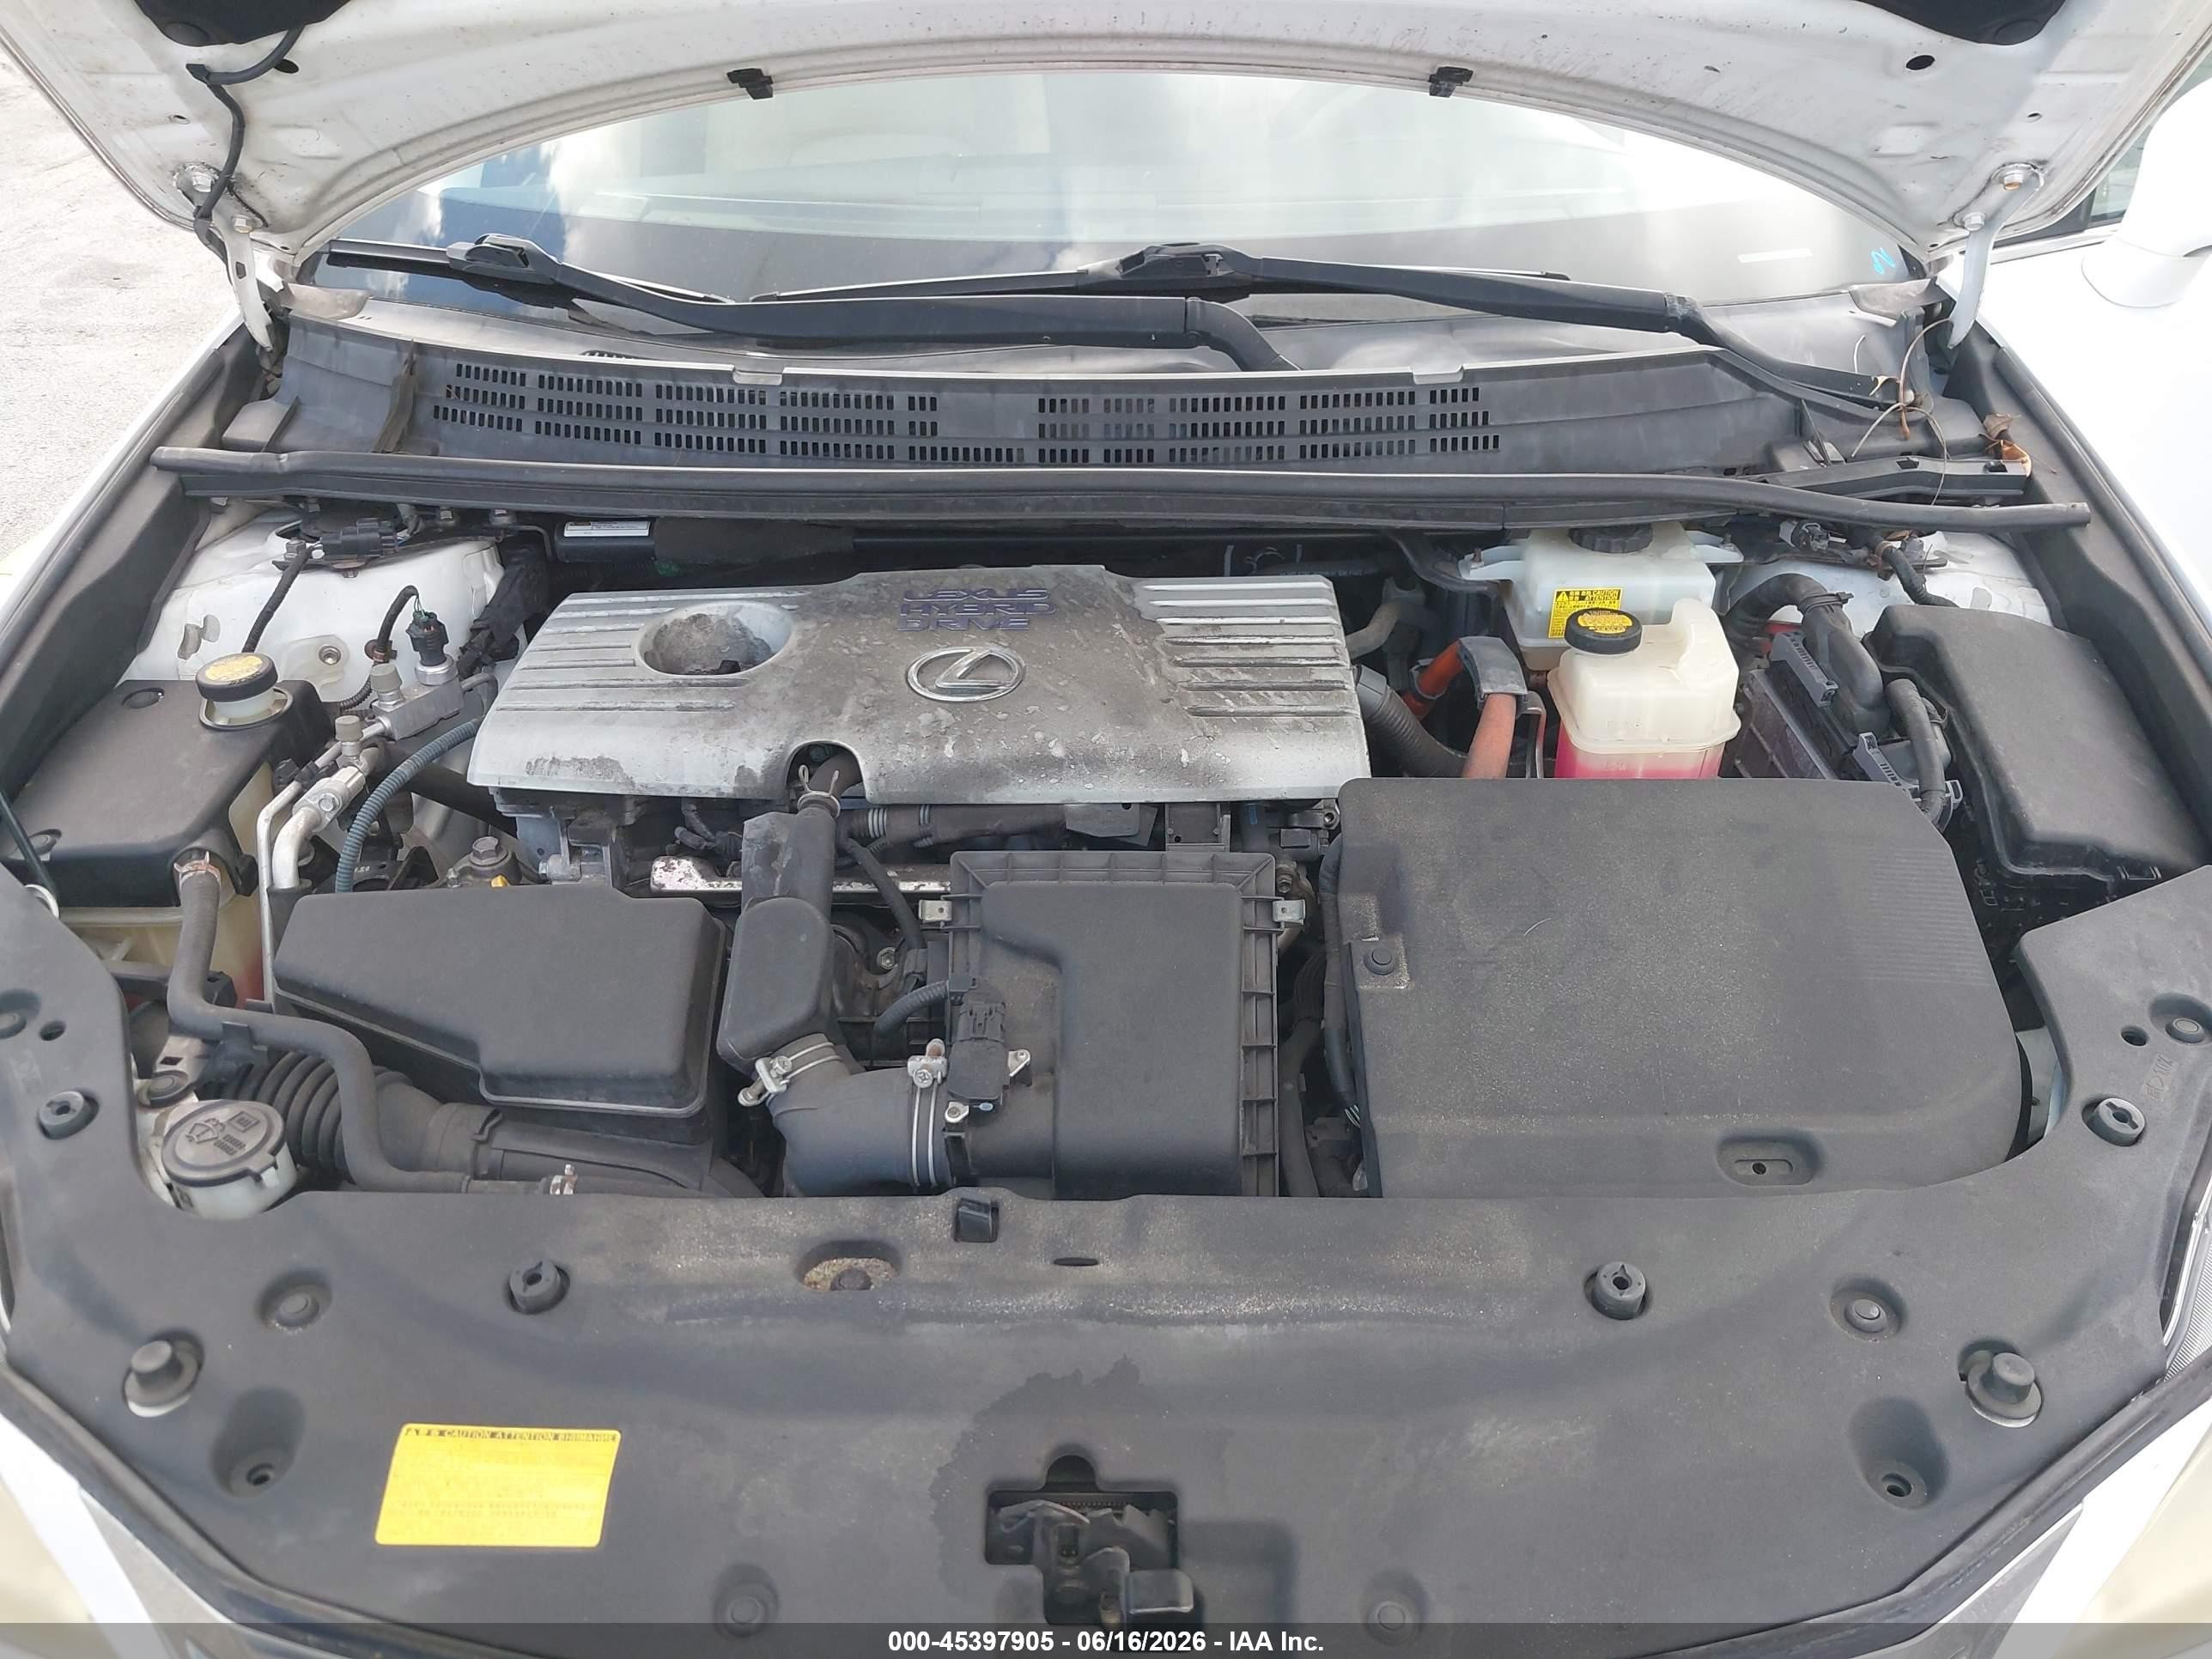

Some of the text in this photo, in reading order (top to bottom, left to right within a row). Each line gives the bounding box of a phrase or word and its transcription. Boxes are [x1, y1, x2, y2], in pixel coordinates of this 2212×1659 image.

[903, 588, 1051, 602] LEXUS
[899, 602, 1057, 617] HYBRID
[896, 617, 1030, 631] DRIVE
[445, 1429, 492, 1439] CAUTION
[495, 1431, 556, 1441] ATTENTION
